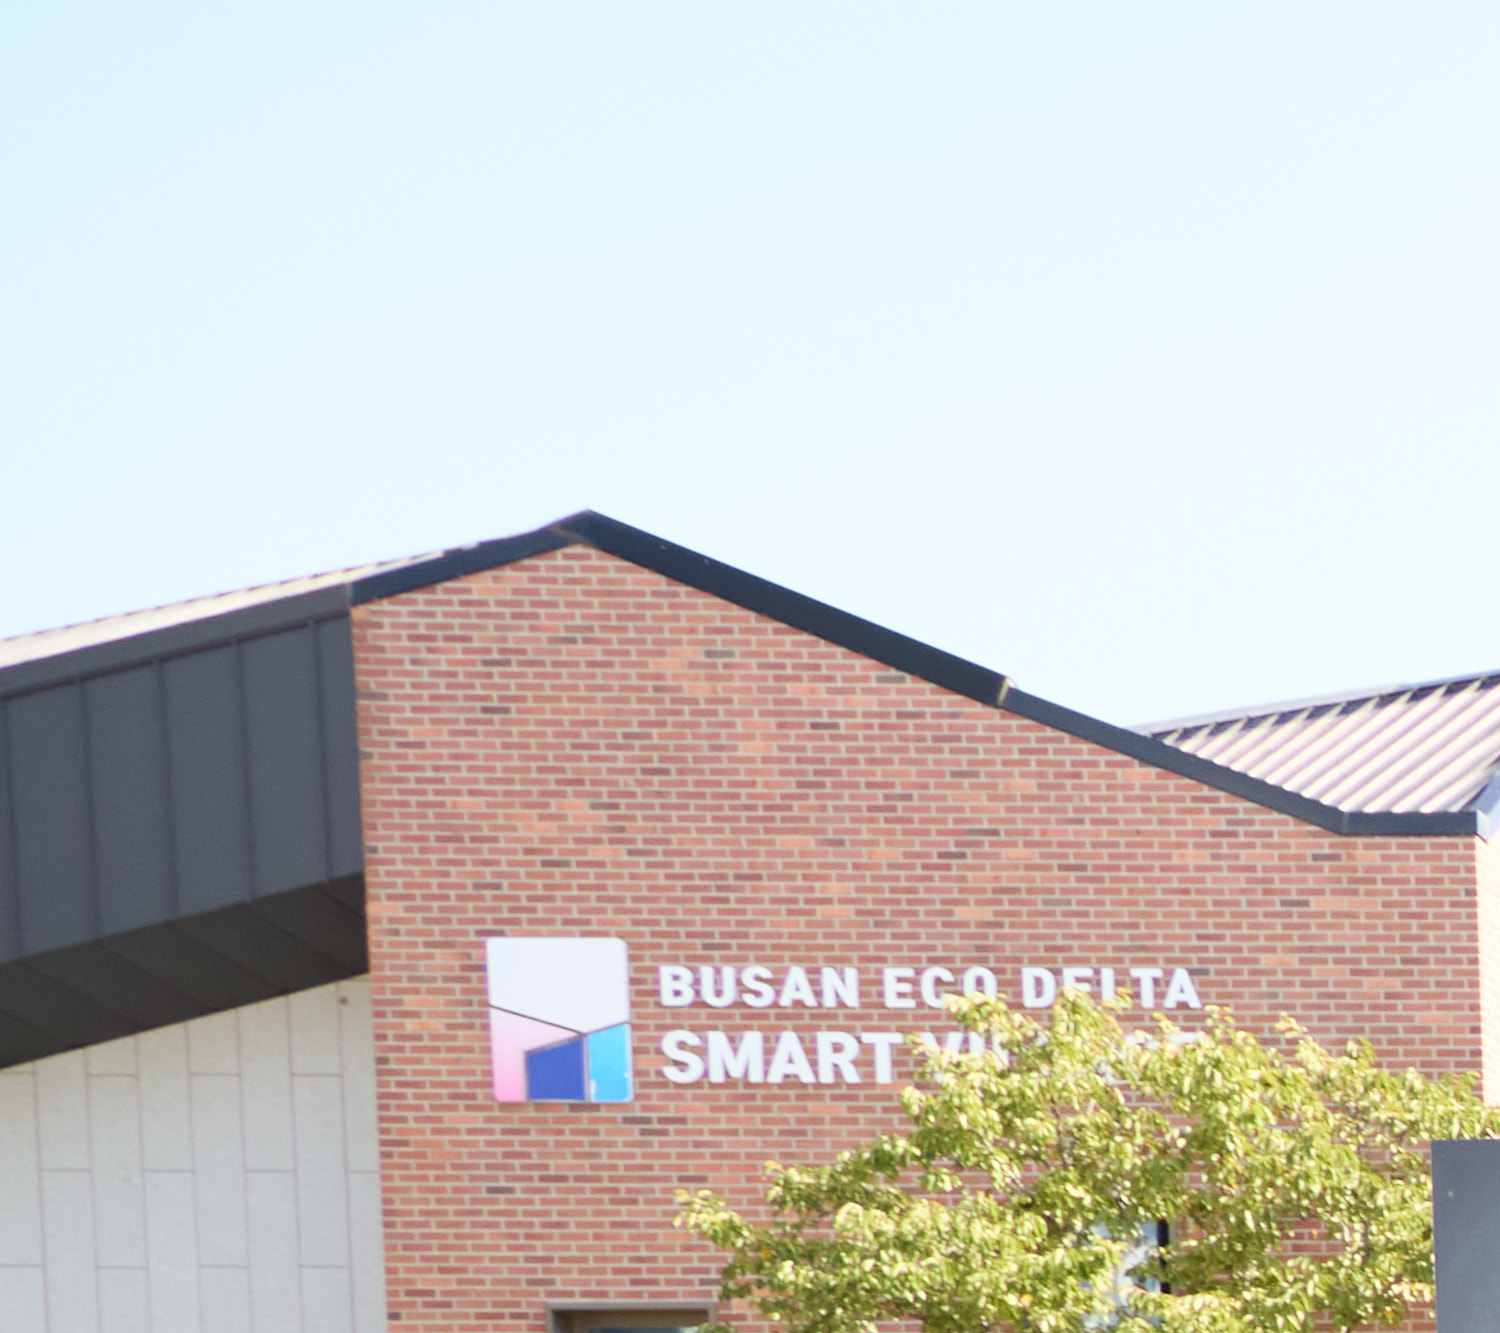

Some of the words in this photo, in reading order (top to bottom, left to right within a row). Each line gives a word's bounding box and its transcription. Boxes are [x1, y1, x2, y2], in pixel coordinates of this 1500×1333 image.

[659, 965, 860, 1009] BUSAN
[883, 966, 998, 1009] ECO
[1021, 967, 1202, 1009] DELTA
[661, 1029, 904, 1084] SMART
